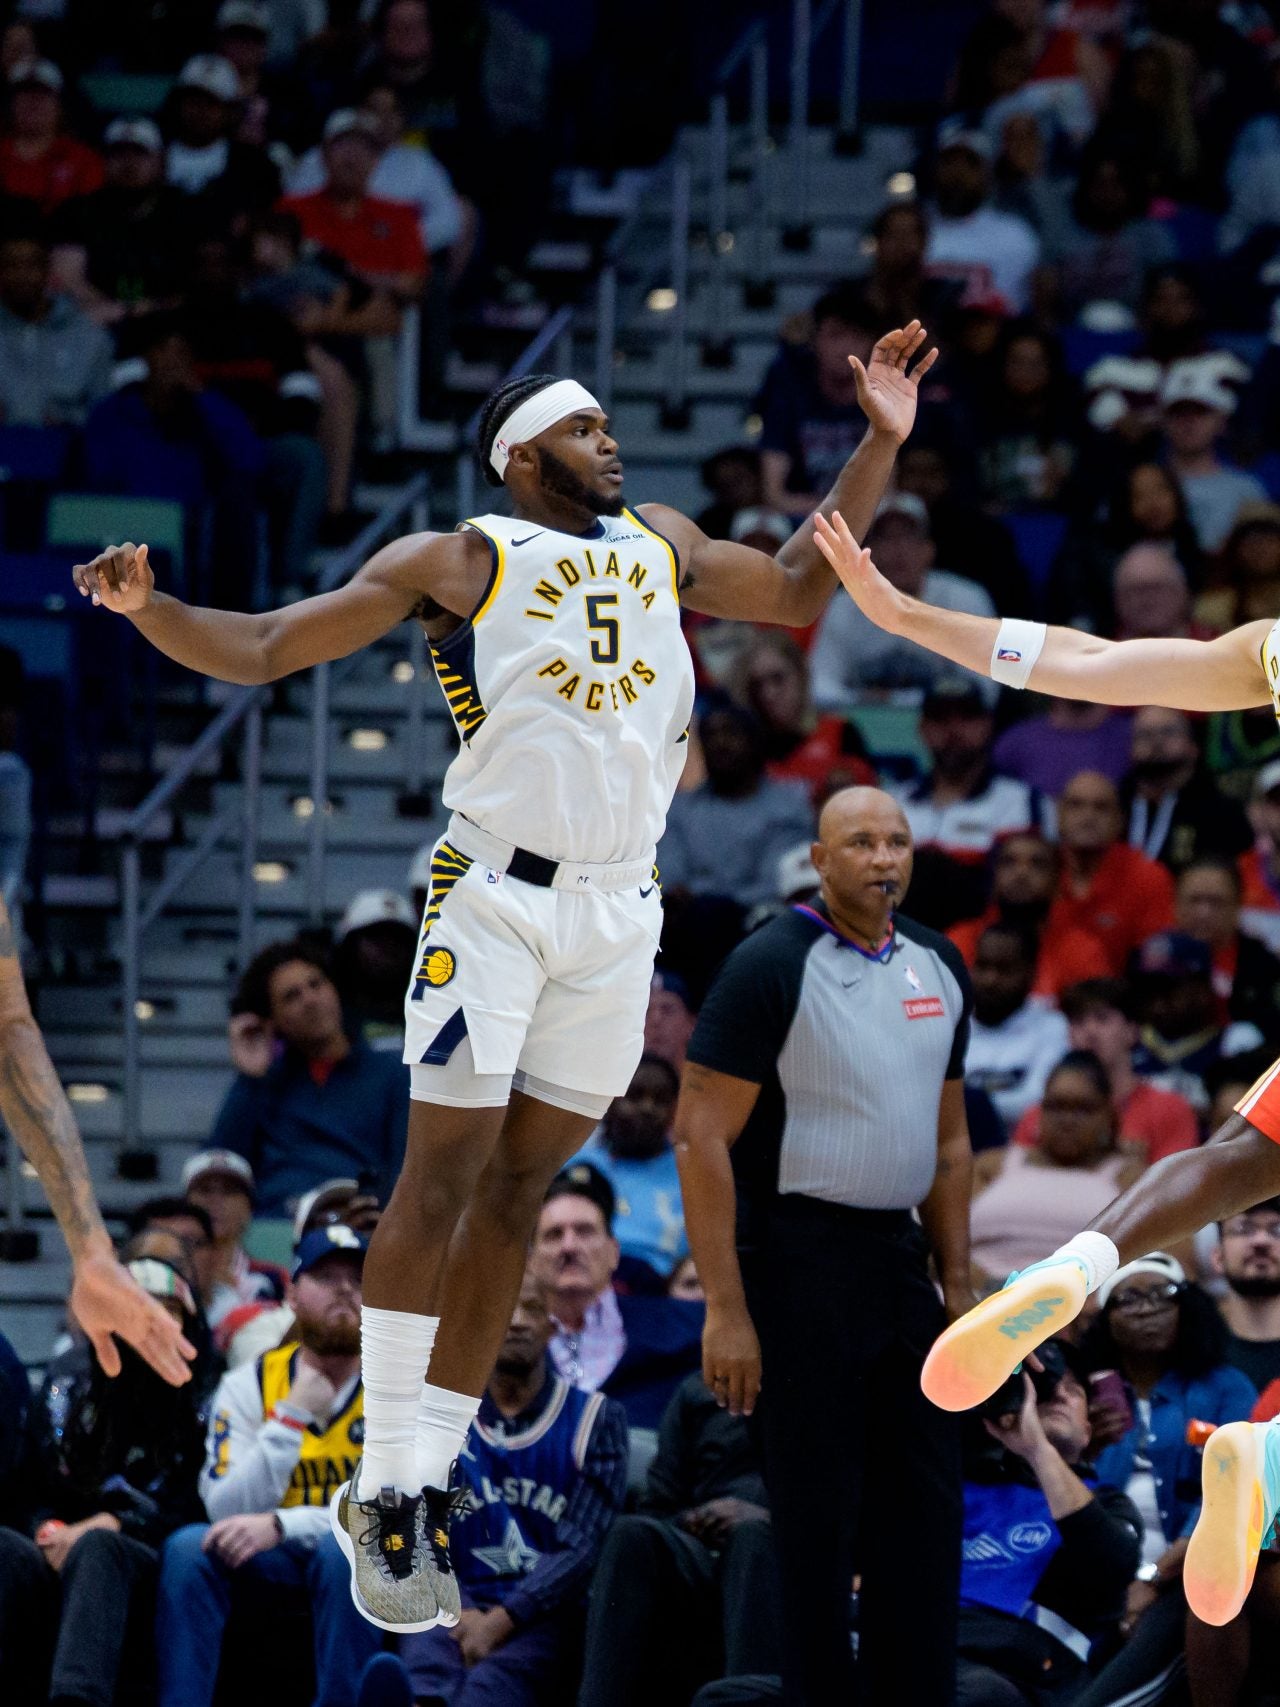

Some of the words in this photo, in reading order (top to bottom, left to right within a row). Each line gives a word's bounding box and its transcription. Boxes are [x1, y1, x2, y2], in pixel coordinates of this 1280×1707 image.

[525, 549, 656, 621] INDIANA
[585, 593, 620, 664] 5
[537, 656, 656, 712] PACERS
